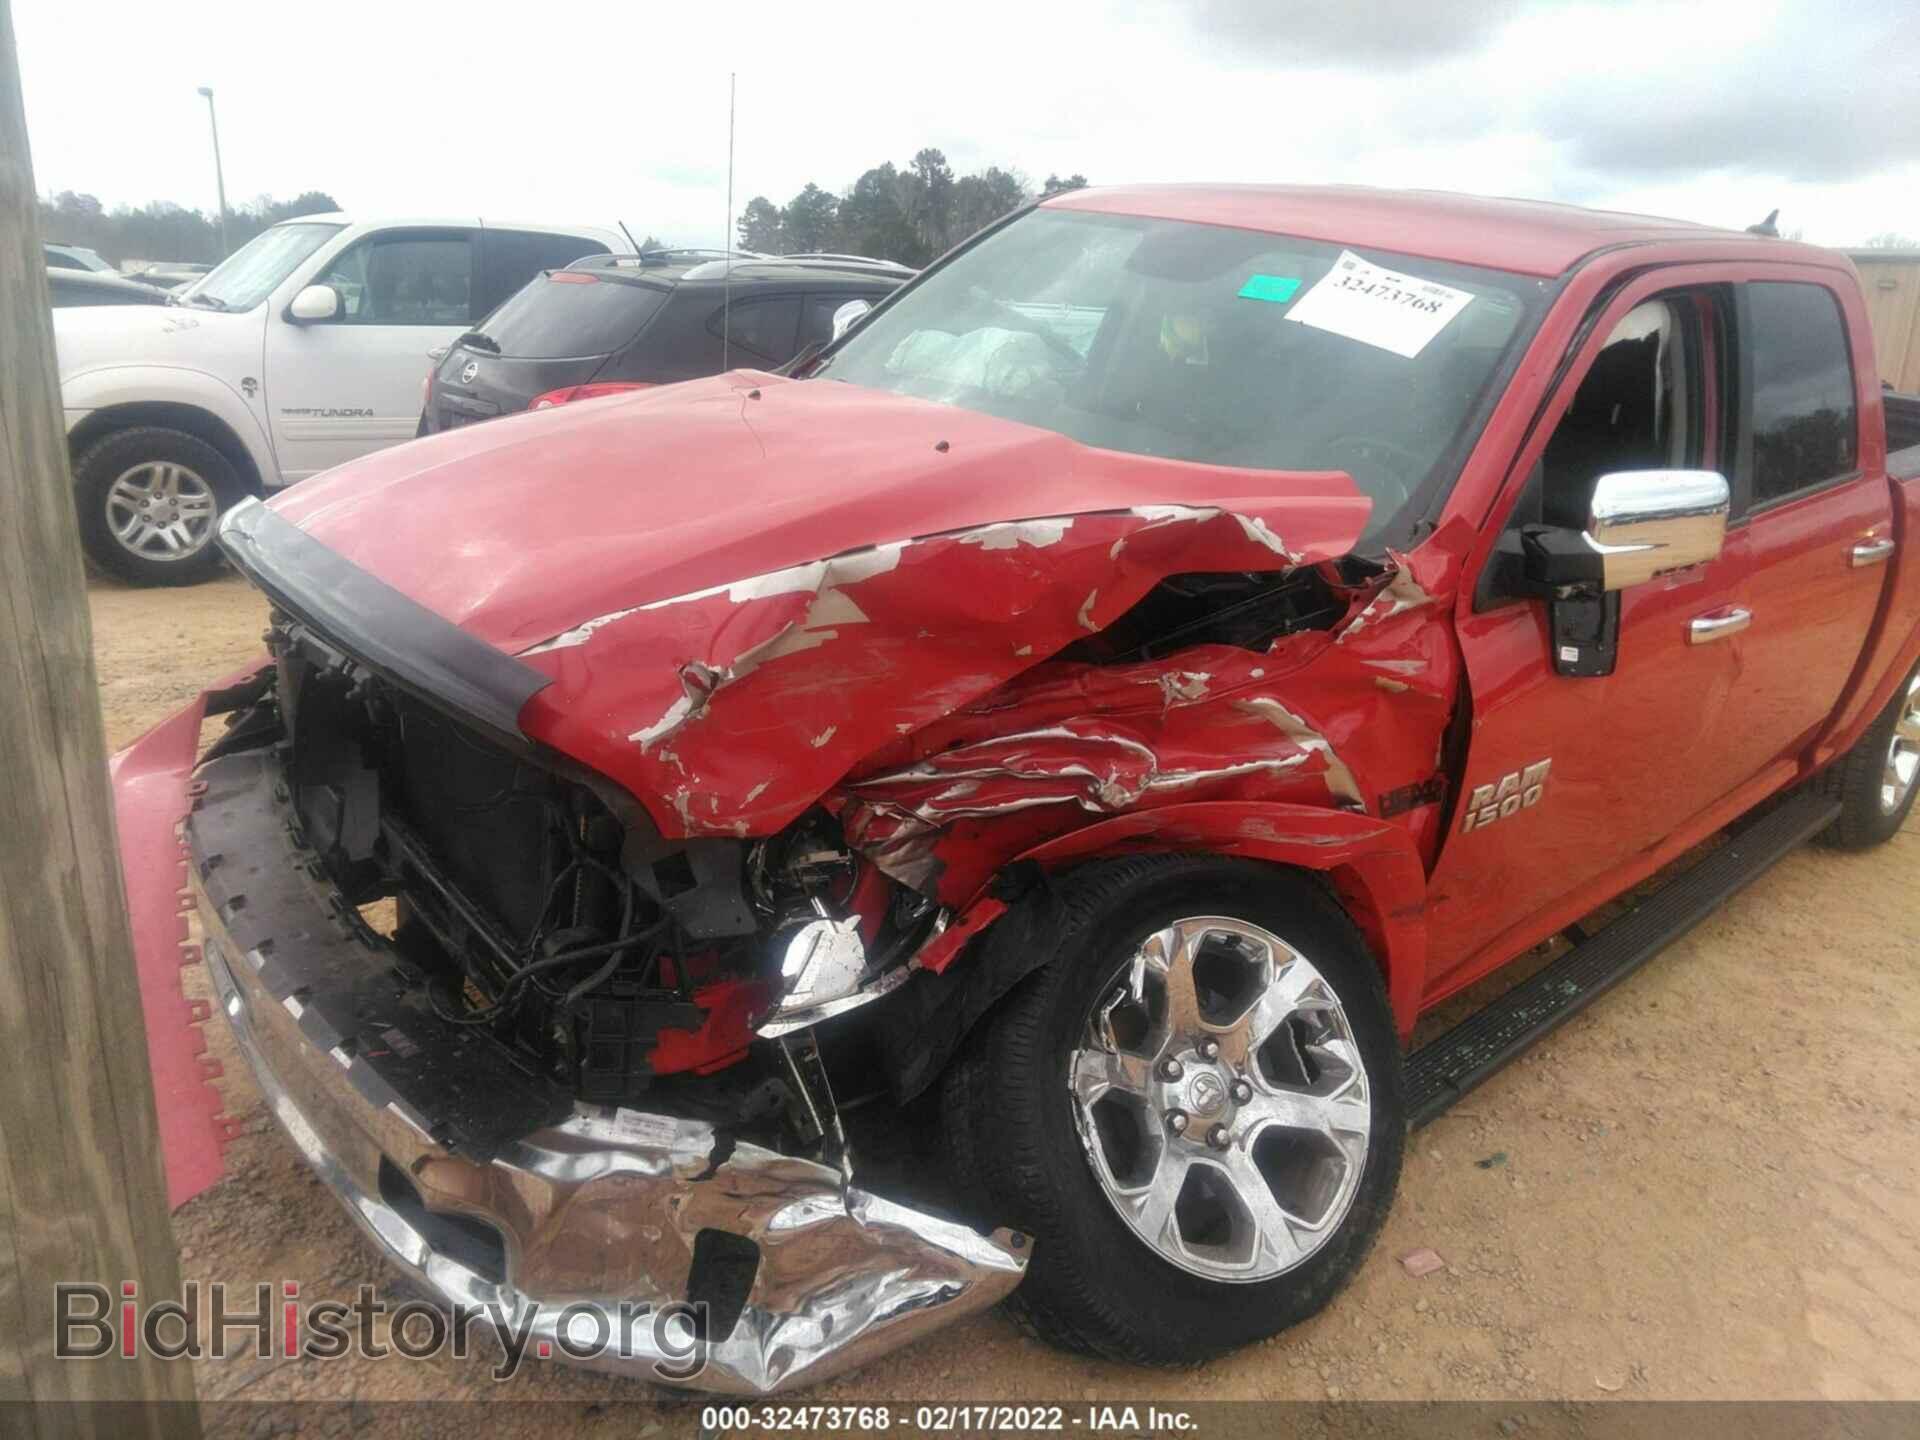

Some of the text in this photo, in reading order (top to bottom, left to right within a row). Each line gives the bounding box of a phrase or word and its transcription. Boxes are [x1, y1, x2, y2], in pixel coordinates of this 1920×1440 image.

[1334, 275, 1443, 313] 32473768
[311, 408, 374, 417] TUNDRA
[1468, 757, 1552, 811] RAM
[1462, 784, 1544, 833] 1500
